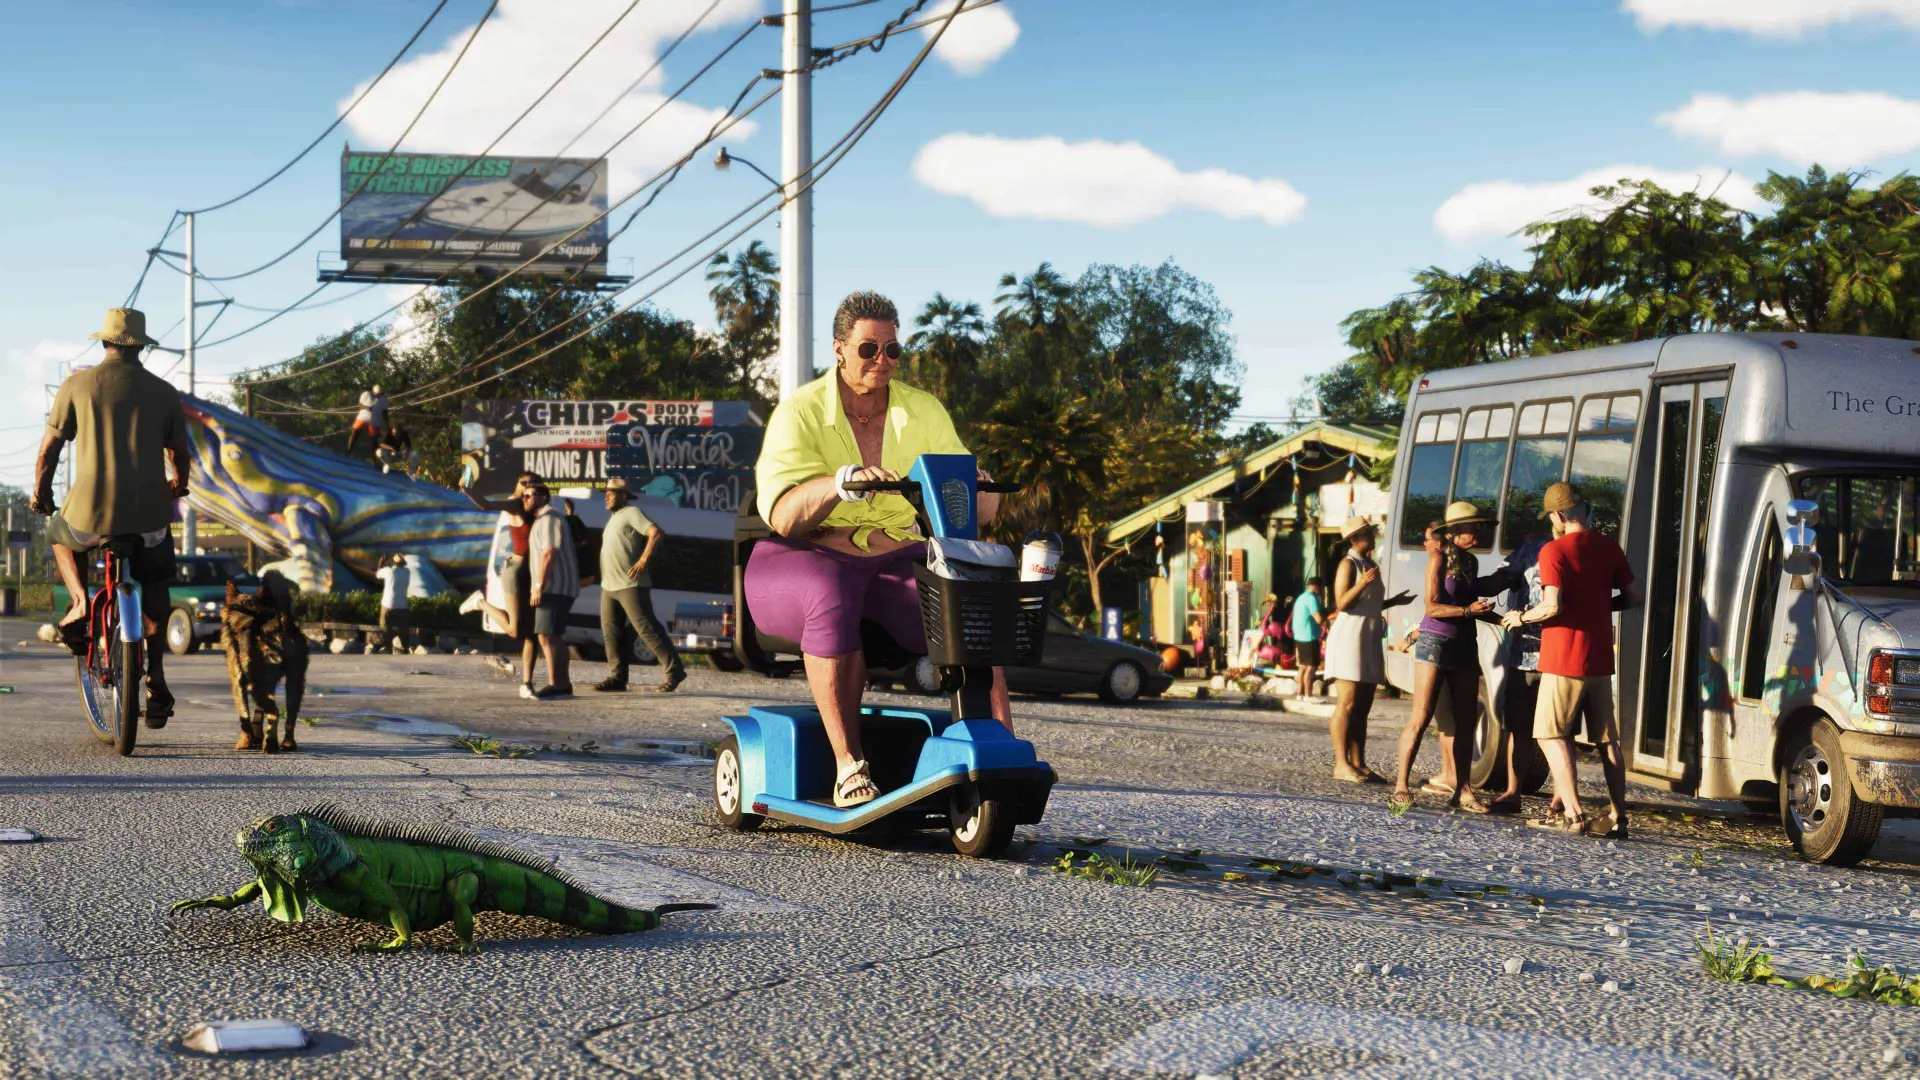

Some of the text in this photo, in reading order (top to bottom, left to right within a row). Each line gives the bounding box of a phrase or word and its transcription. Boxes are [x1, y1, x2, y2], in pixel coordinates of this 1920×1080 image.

[654, 403, 699, 415] BODY
[1826, 390, 1875, 413] The
[527, 402, 648, 426] CHIP'S
[654, 415, 700, 426] SHOP
[537, 429, 607, 437] SENIOR AND MI
[523, 450, 581, 479] HAVING
[584, 450, 596, 479] A
[675, 471, 740, 512] Whal
